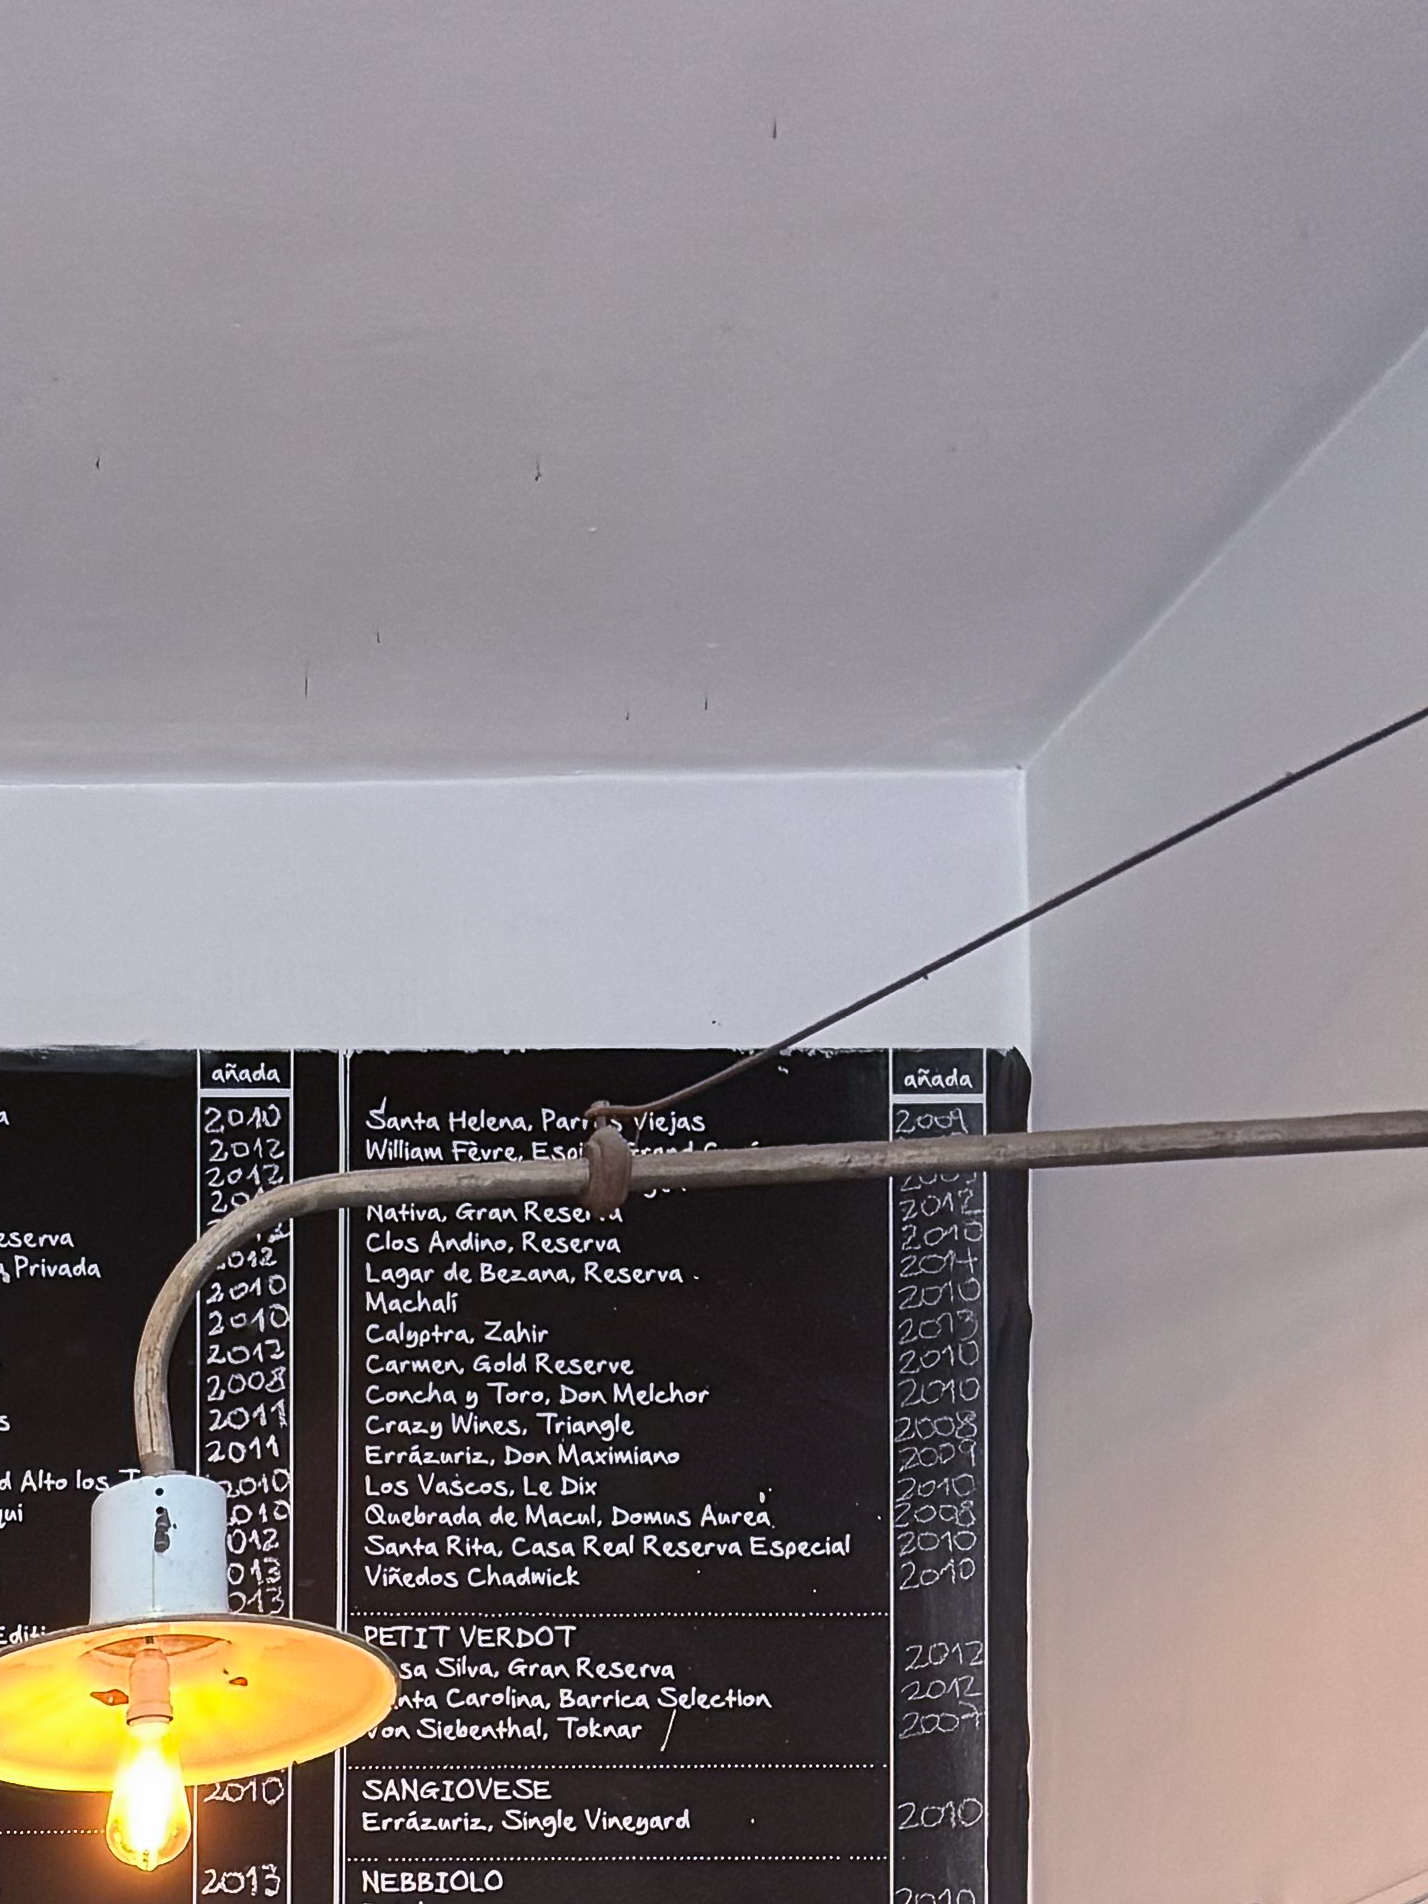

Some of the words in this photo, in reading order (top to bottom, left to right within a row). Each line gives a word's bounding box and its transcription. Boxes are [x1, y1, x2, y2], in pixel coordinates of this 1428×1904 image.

[211, 1063, 279, 1085] añada
[903, 1068, 973, 1090] añada
[204, 1104, 281, 1132] 2010
[895, 1110, 965, 1133] 2009
[365, 1229, 420, 1254] Clos
[428, 1230, 514, 1254] Andino,
[521, 1230, 622, 1254] Reserva
[365, 1321, 475, 1349] Calyptra,
[483, 1320, 549, 1344] Zahir
[206, 1341, 286, 1366] 2012
[206, 1436, 279, 1464] 2011
[364, 1563, 459, 1589] Viñedos
[467, 1563, 581, 1588] Chadwick
[364, 1624, 451, 1650] PETIT
[459, 1624, 577, 1649] VERDOT
[361, 1776, 553, 1803] SANGIOVESE
[361, 1869, 504, 1894] NEBBIOLO
